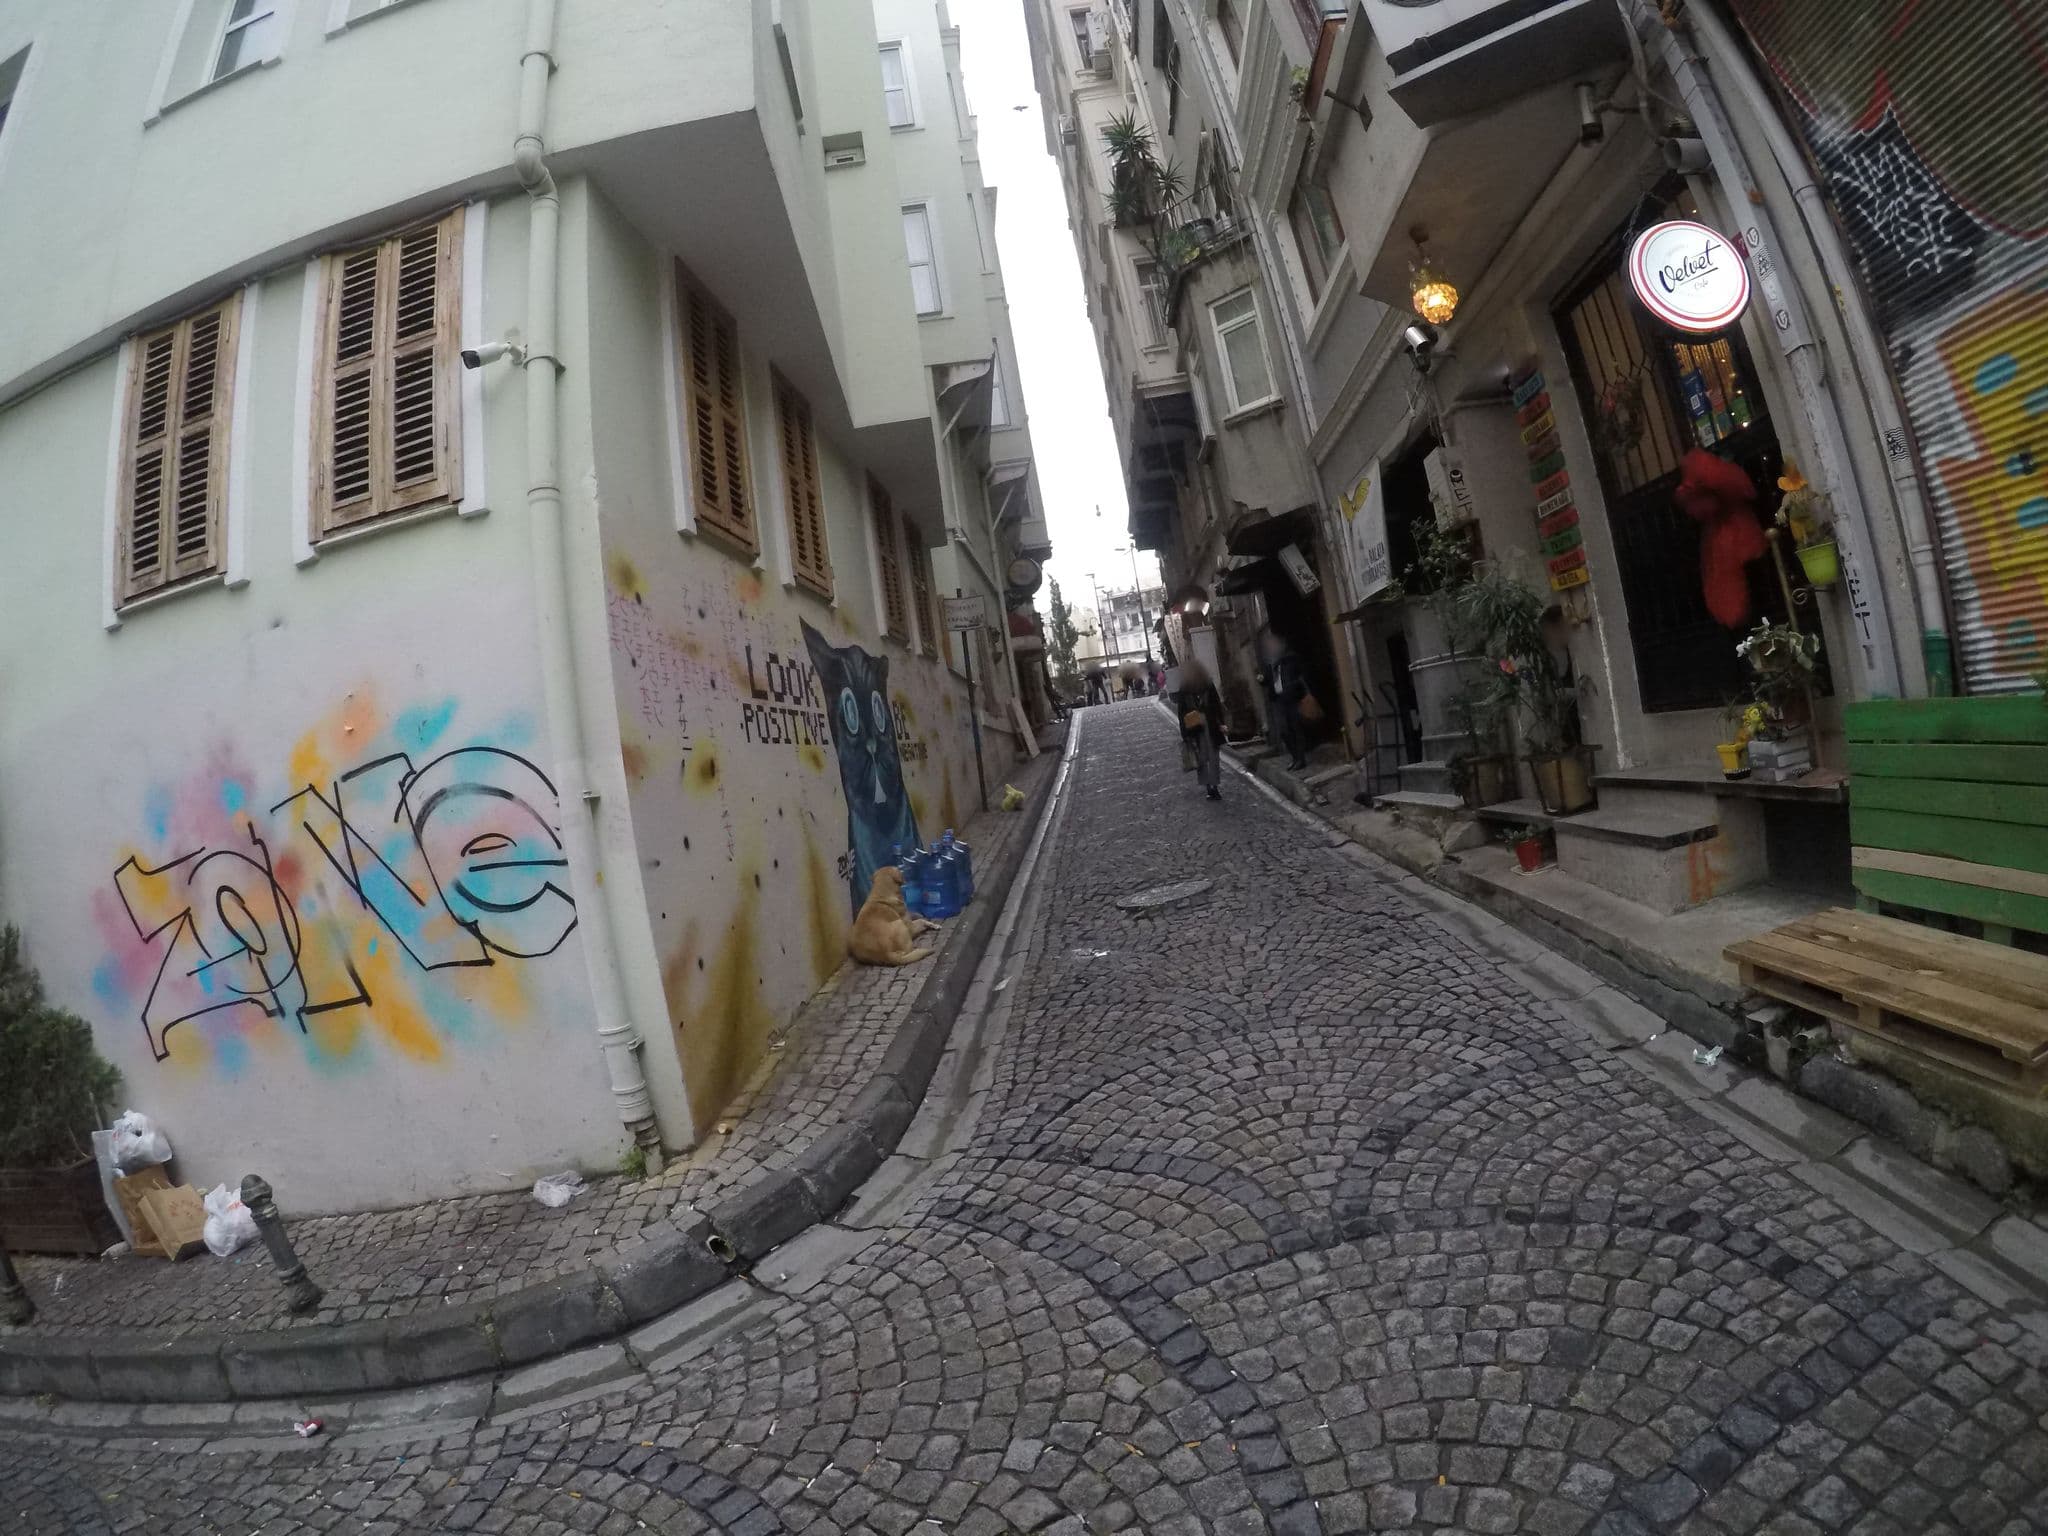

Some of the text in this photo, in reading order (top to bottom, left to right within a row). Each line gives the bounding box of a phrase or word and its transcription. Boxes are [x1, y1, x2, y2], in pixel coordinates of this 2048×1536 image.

[1659, 239, 1721, 293] Velvet
[745, 645, 819, 708] LOOK
[743, 703, 829, 745] POSITIVE
